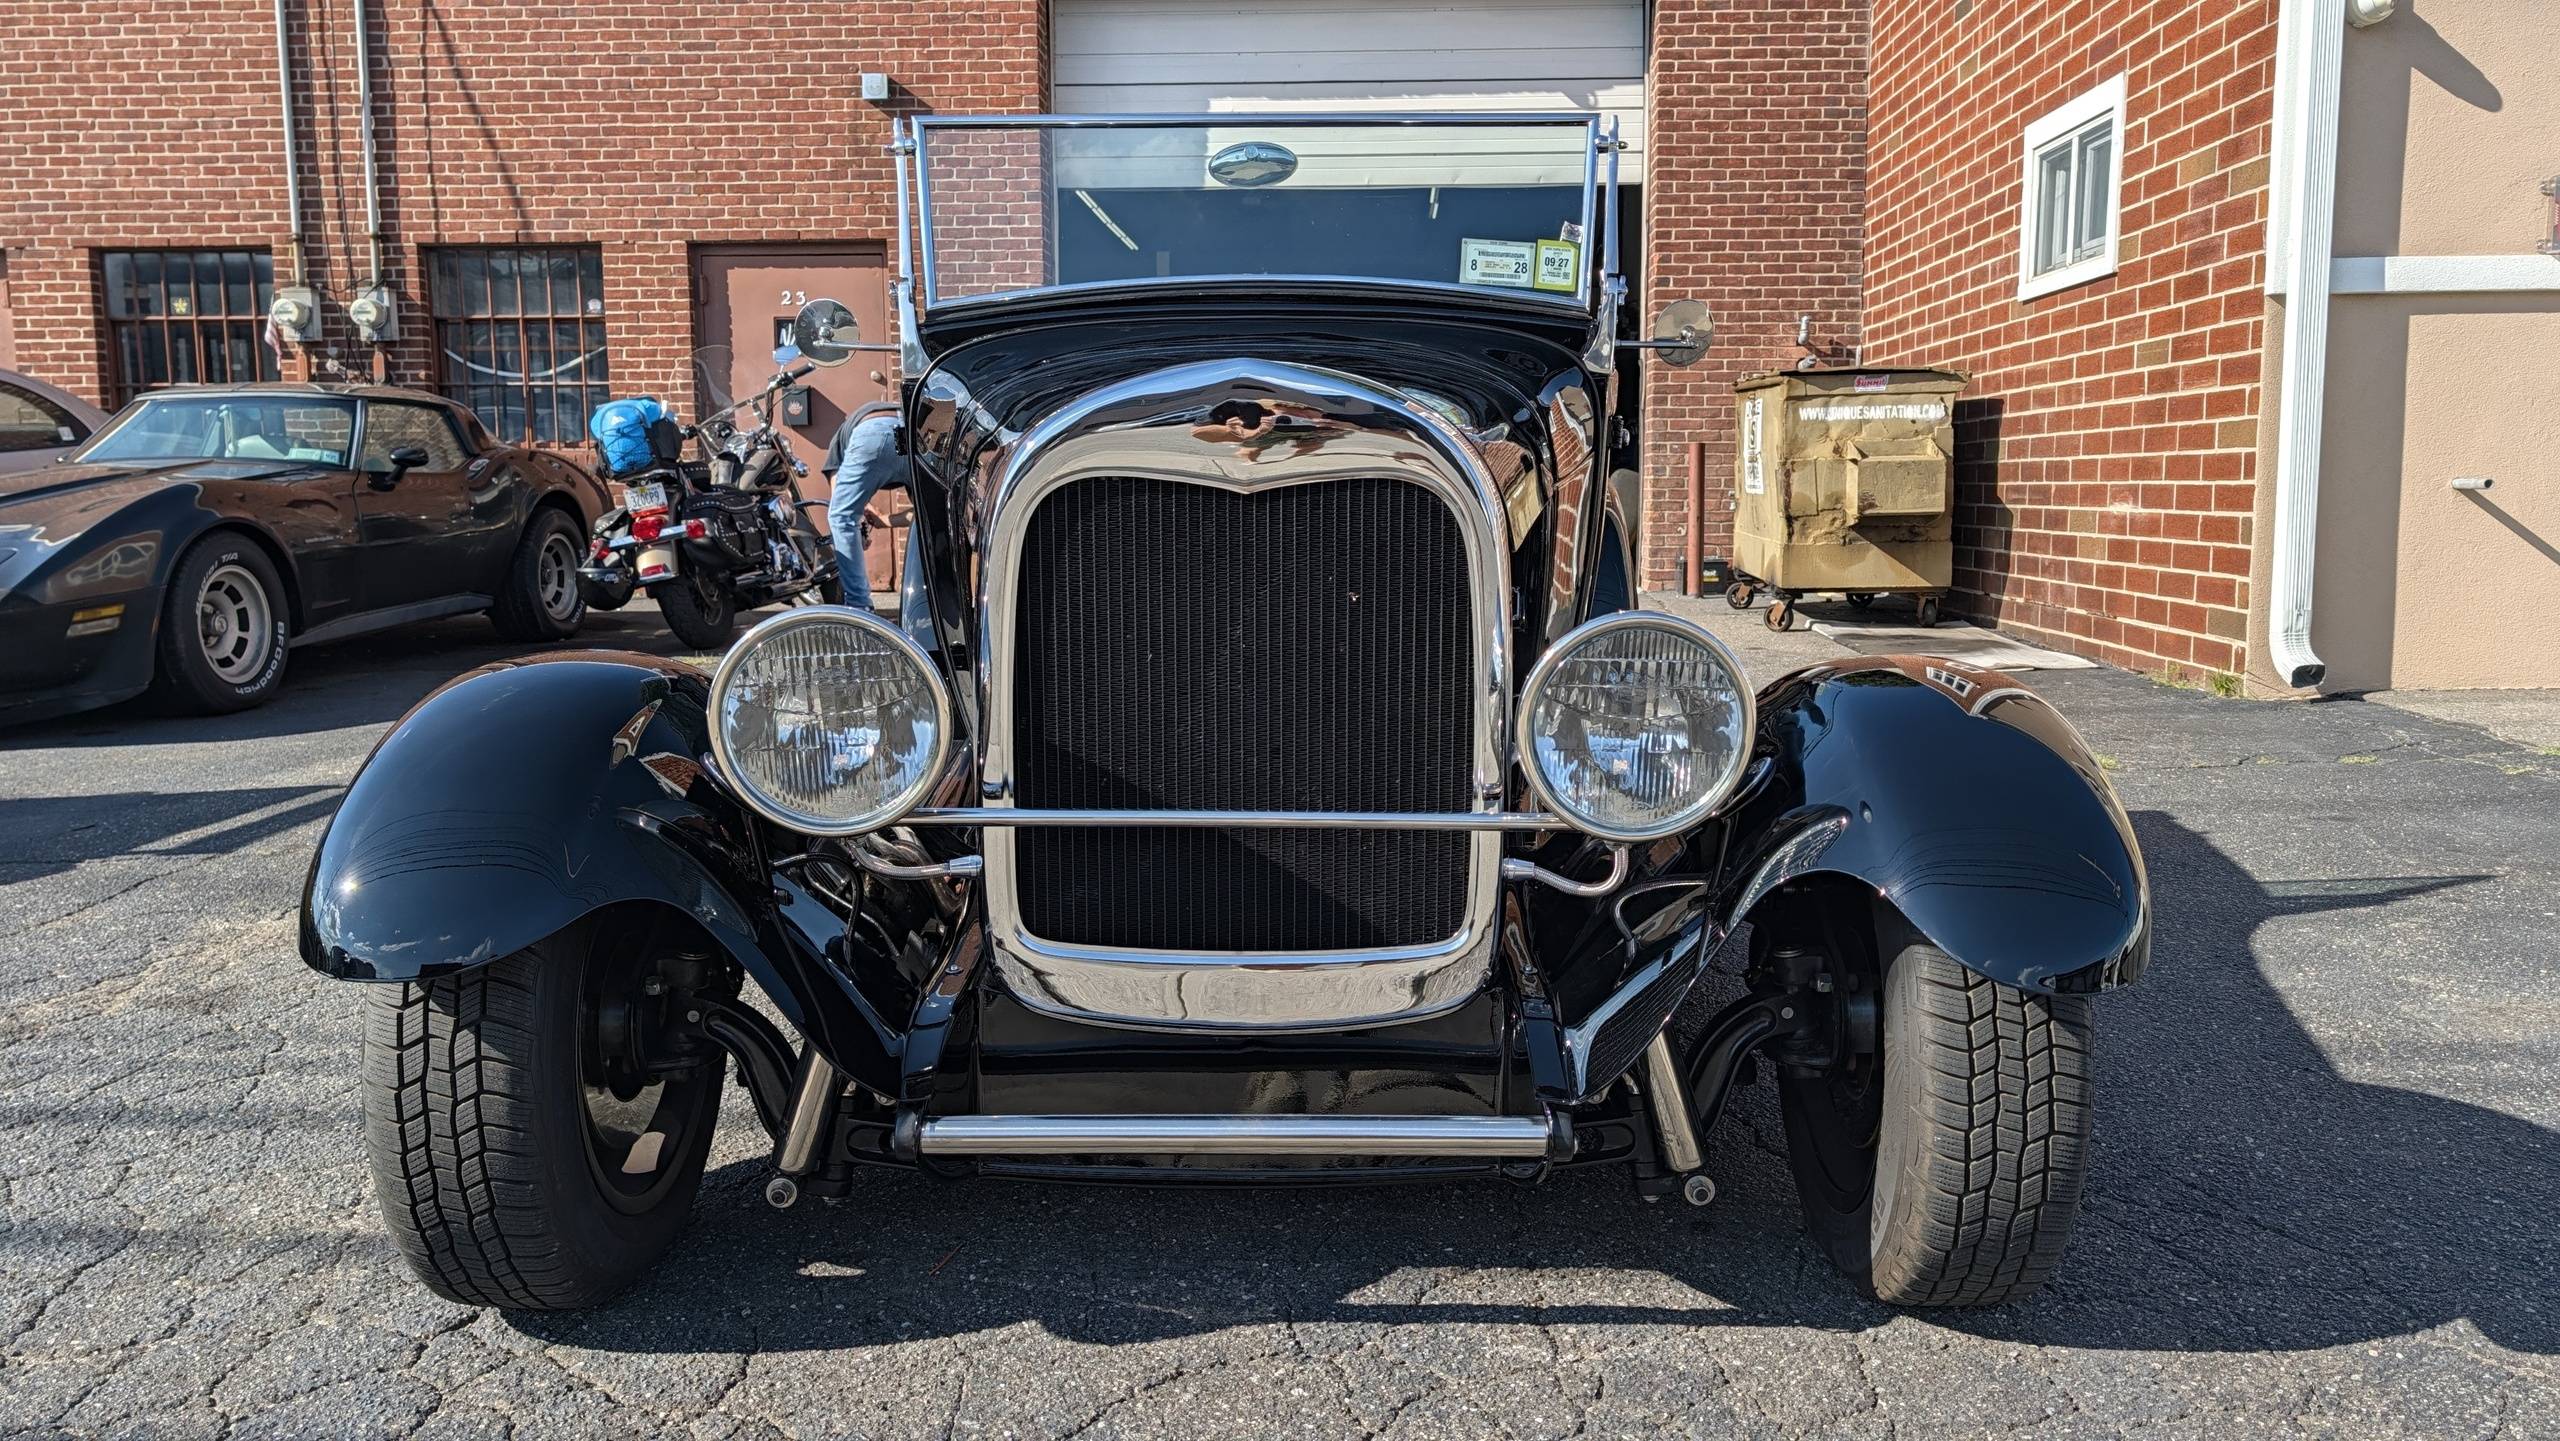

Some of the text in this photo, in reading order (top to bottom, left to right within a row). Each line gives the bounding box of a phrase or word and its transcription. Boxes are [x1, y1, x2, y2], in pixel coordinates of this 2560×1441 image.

[1470, 258, 1478, 271] 8
[1514, 261, 1528, 274] 28
[1544, 256, 1569, 268] 09 27
[780, 290, 806, 306] 23
[221, 552, 239, 563] T/A
[235, 621, 285, 696] BFGoodrich
